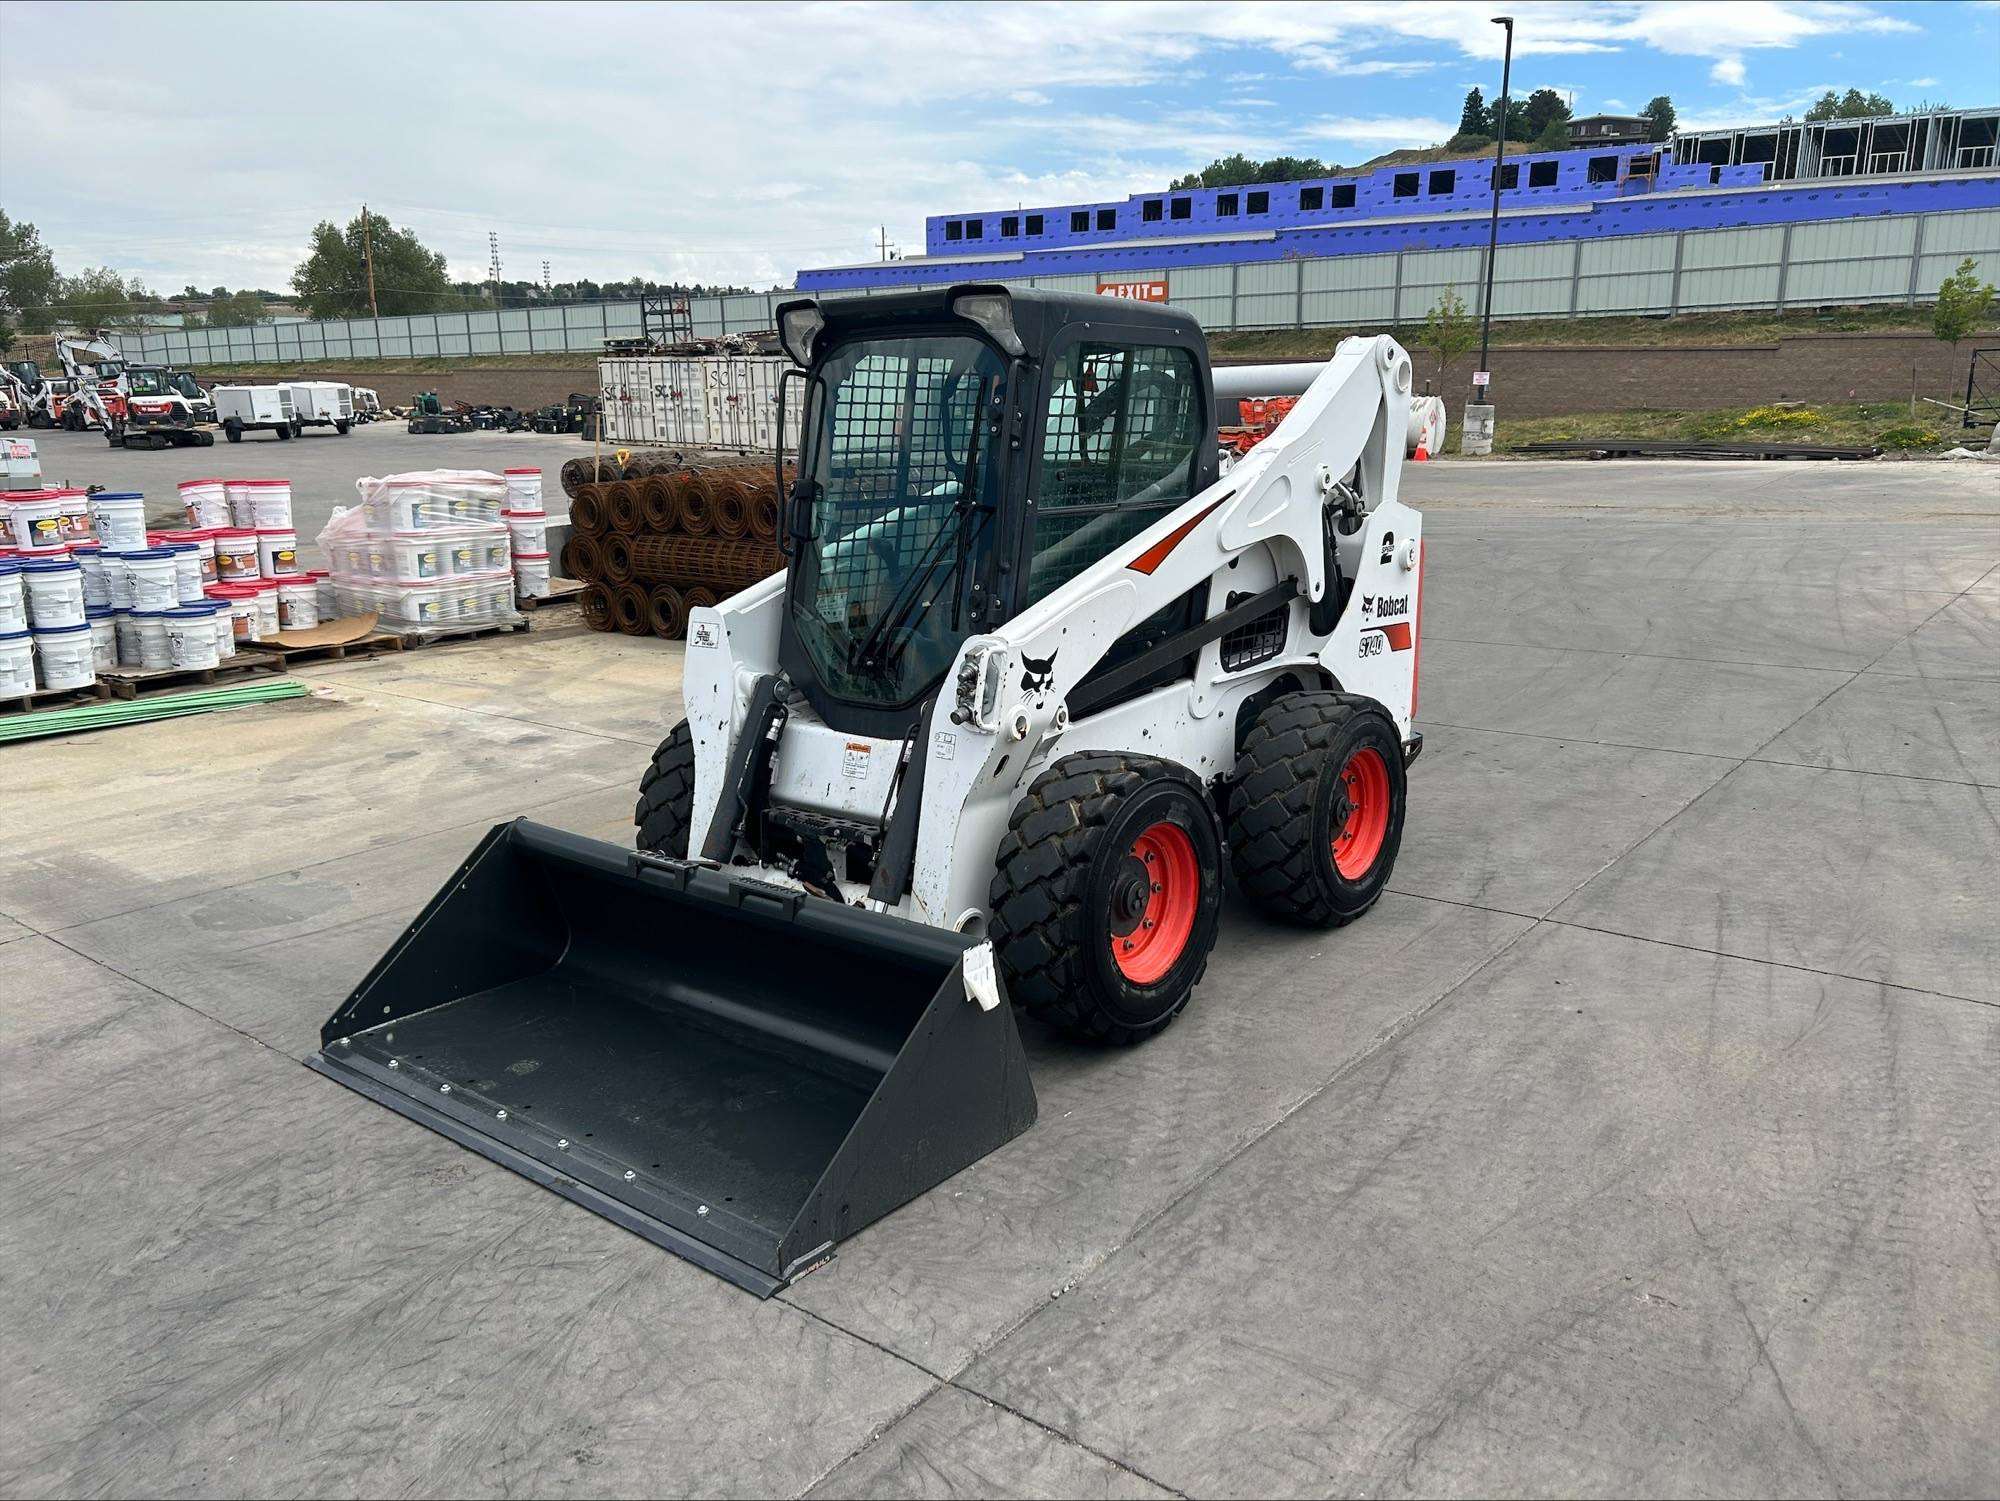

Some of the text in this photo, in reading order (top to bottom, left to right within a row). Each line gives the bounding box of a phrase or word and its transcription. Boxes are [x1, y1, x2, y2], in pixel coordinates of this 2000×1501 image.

[1118, 284, 1150, 299] EXIT
[1379, 531, 1395, 566] 2
[1377, 594, 1408, 618] Bobcat
[1358, 634, 1384, 659] S740
